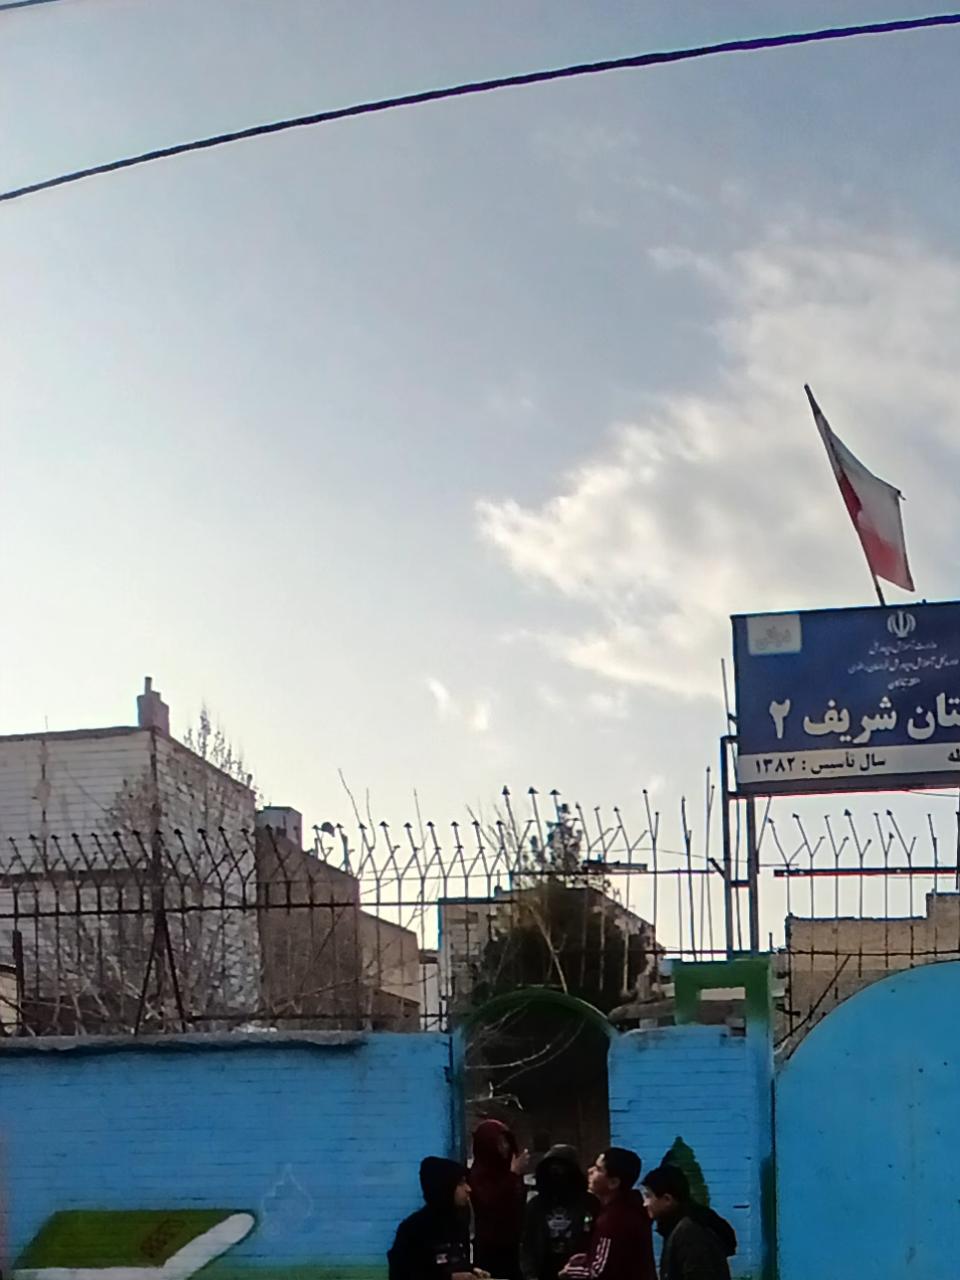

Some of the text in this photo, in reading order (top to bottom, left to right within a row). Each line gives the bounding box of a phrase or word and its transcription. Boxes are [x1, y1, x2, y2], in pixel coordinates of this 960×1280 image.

[768, 698, 791, 740] ۲
[803, 696, 898, 744] شریف
[859, 752, 886, 771] سال
